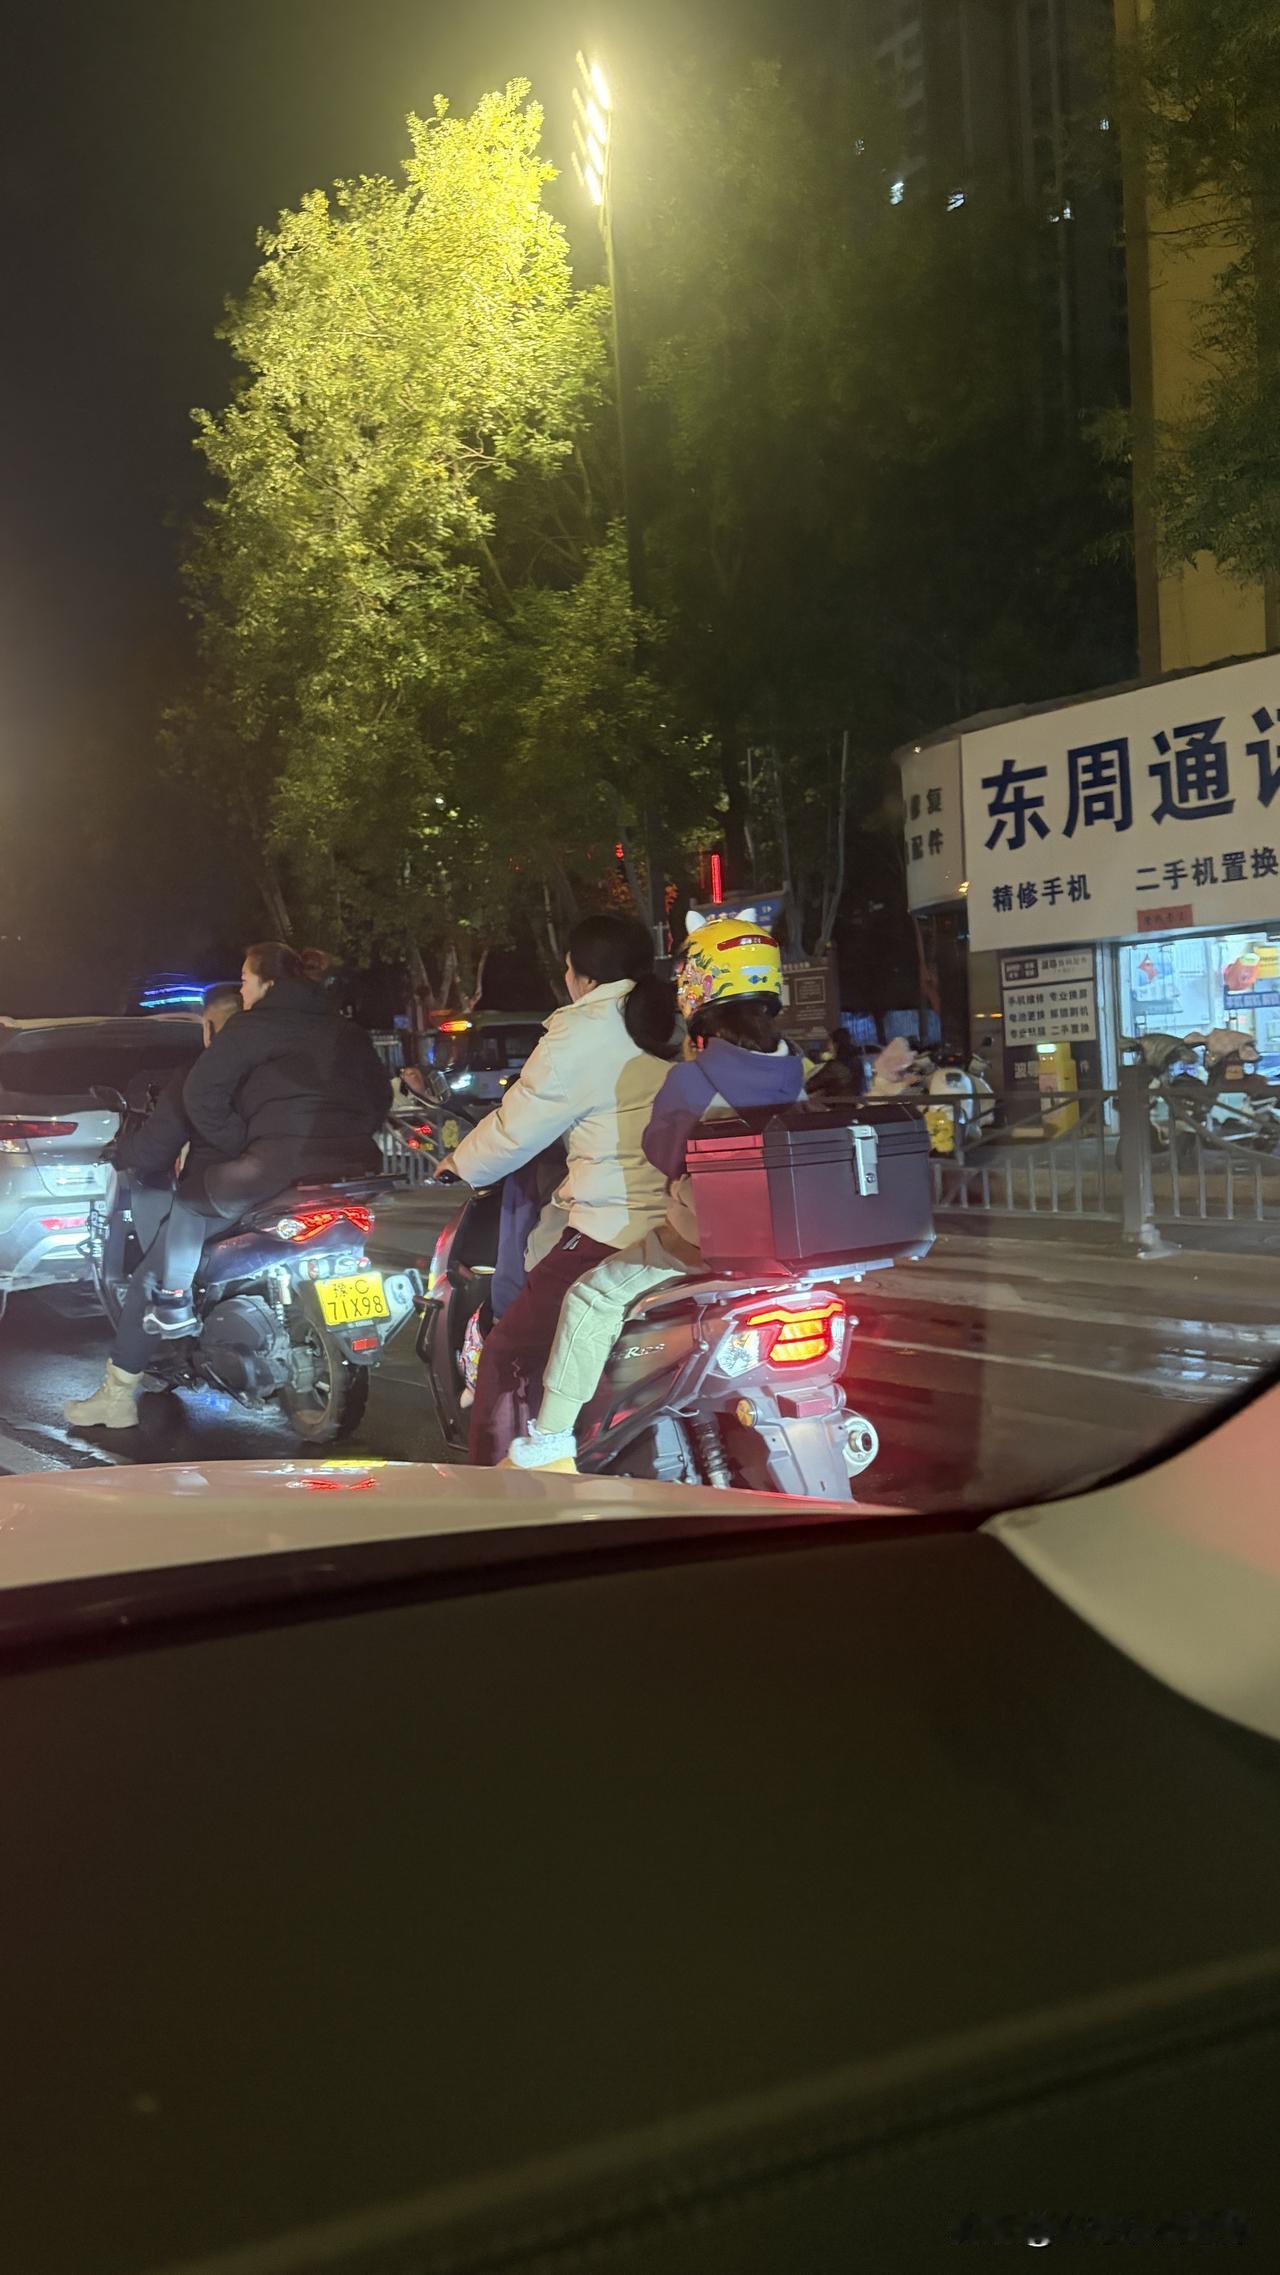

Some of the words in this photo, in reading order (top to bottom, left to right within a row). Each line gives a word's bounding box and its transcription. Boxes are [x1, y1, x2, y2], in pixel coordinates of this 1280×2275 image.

[1136, 847, 1279, 891] 二手机置换
[992, 874, 1091, 912] 精修手机
[327, 1295, 384, 1321] 71X98
